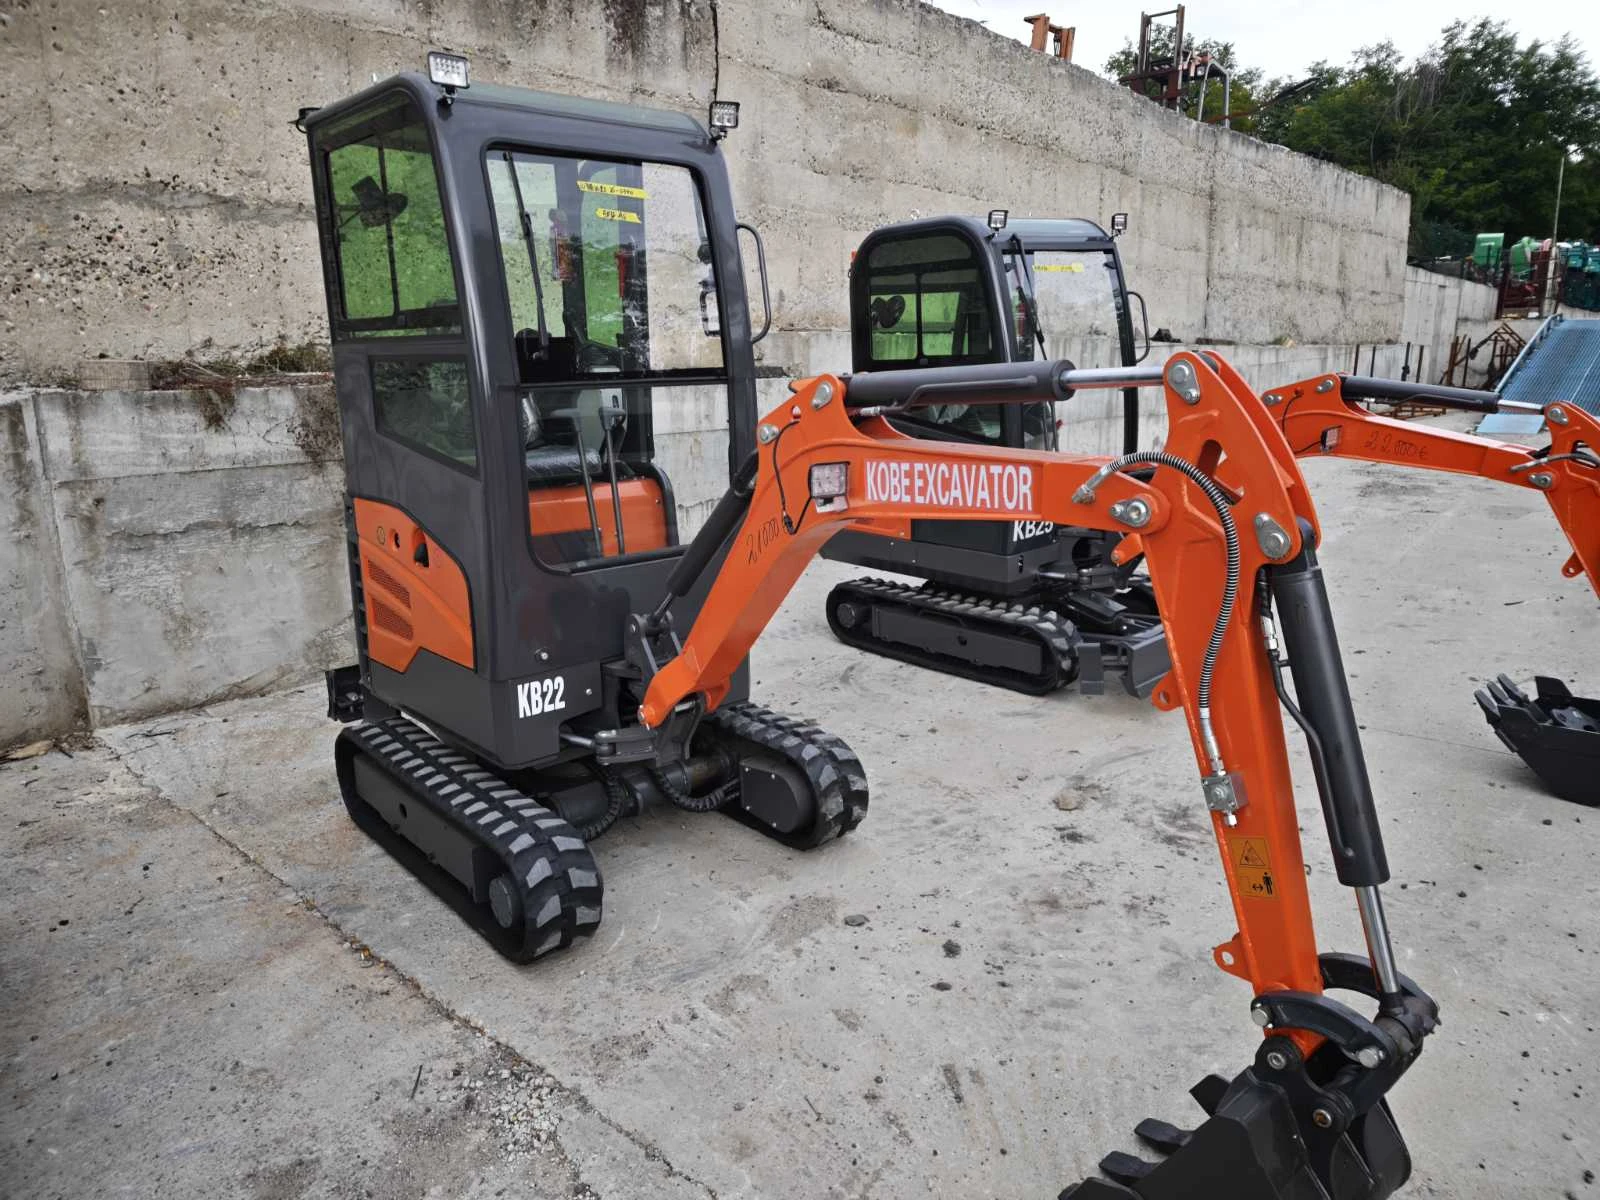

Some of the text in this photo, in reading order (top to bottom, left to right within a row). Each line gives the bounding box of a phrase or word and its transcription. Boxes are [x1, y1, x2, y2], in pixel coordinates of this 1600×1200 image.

[866, 460, 1033, 511] KOBE EXCAVATOR
[1012, 520, 1054, 542] KB25
[517, 676, 566, 719] KB22
